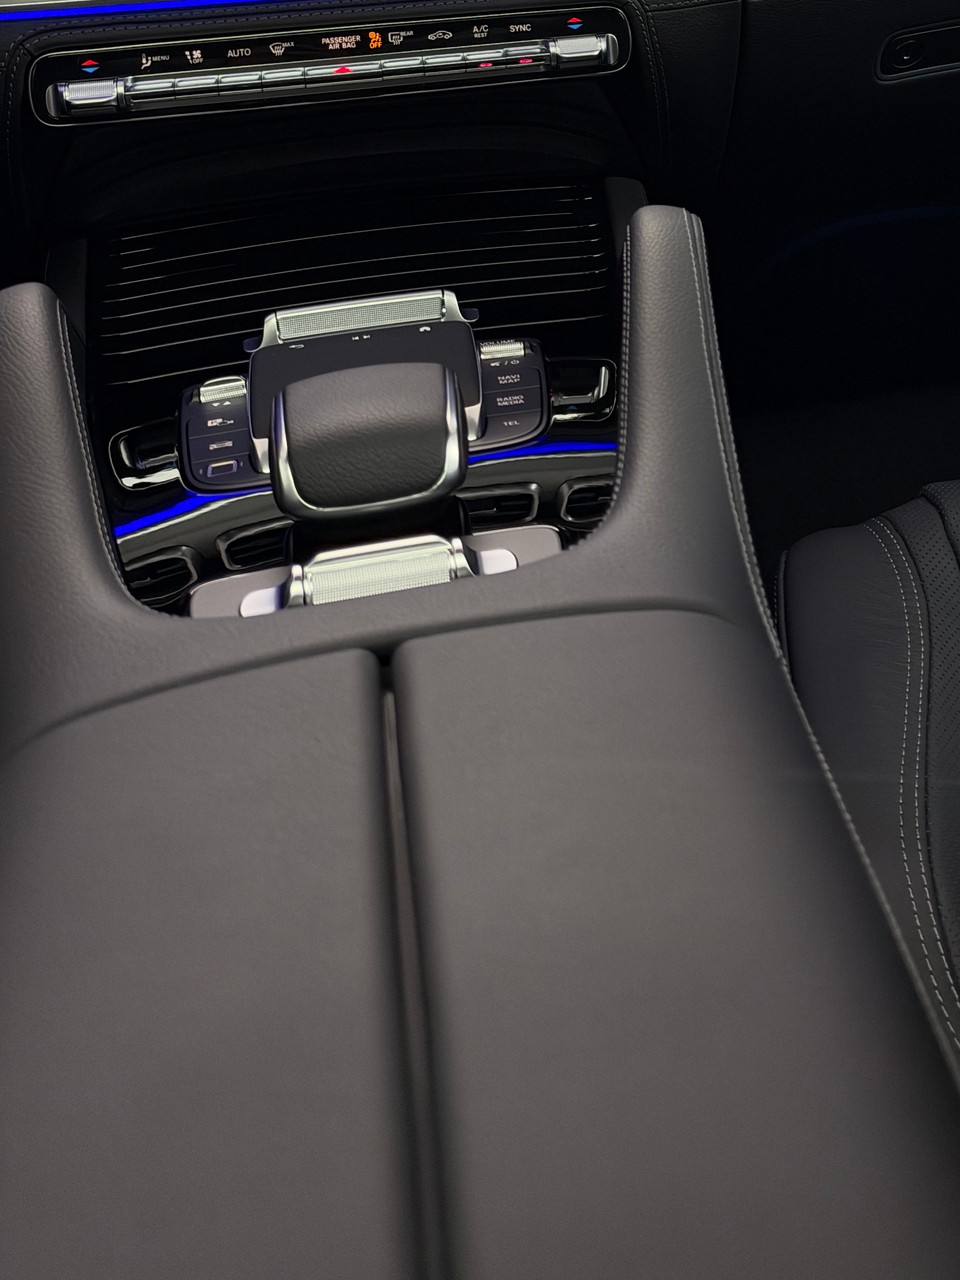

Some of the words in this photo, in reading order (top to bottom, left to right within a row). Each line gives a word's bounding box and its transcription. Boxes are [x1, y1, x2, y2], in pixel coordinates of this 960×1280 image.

[472, 24, 489, 34] A/C
[509, 23, 532, 33] SYNC
[321, 34, 361, 45] PASSENGER
[328, 42, 341, 50] AIR
[341, 40, 357, 50] BAG
[369, 40, 383, 50] OFF
[152, 54, 170, 62] MENU
[227, 47, 252, 59] AUTO
